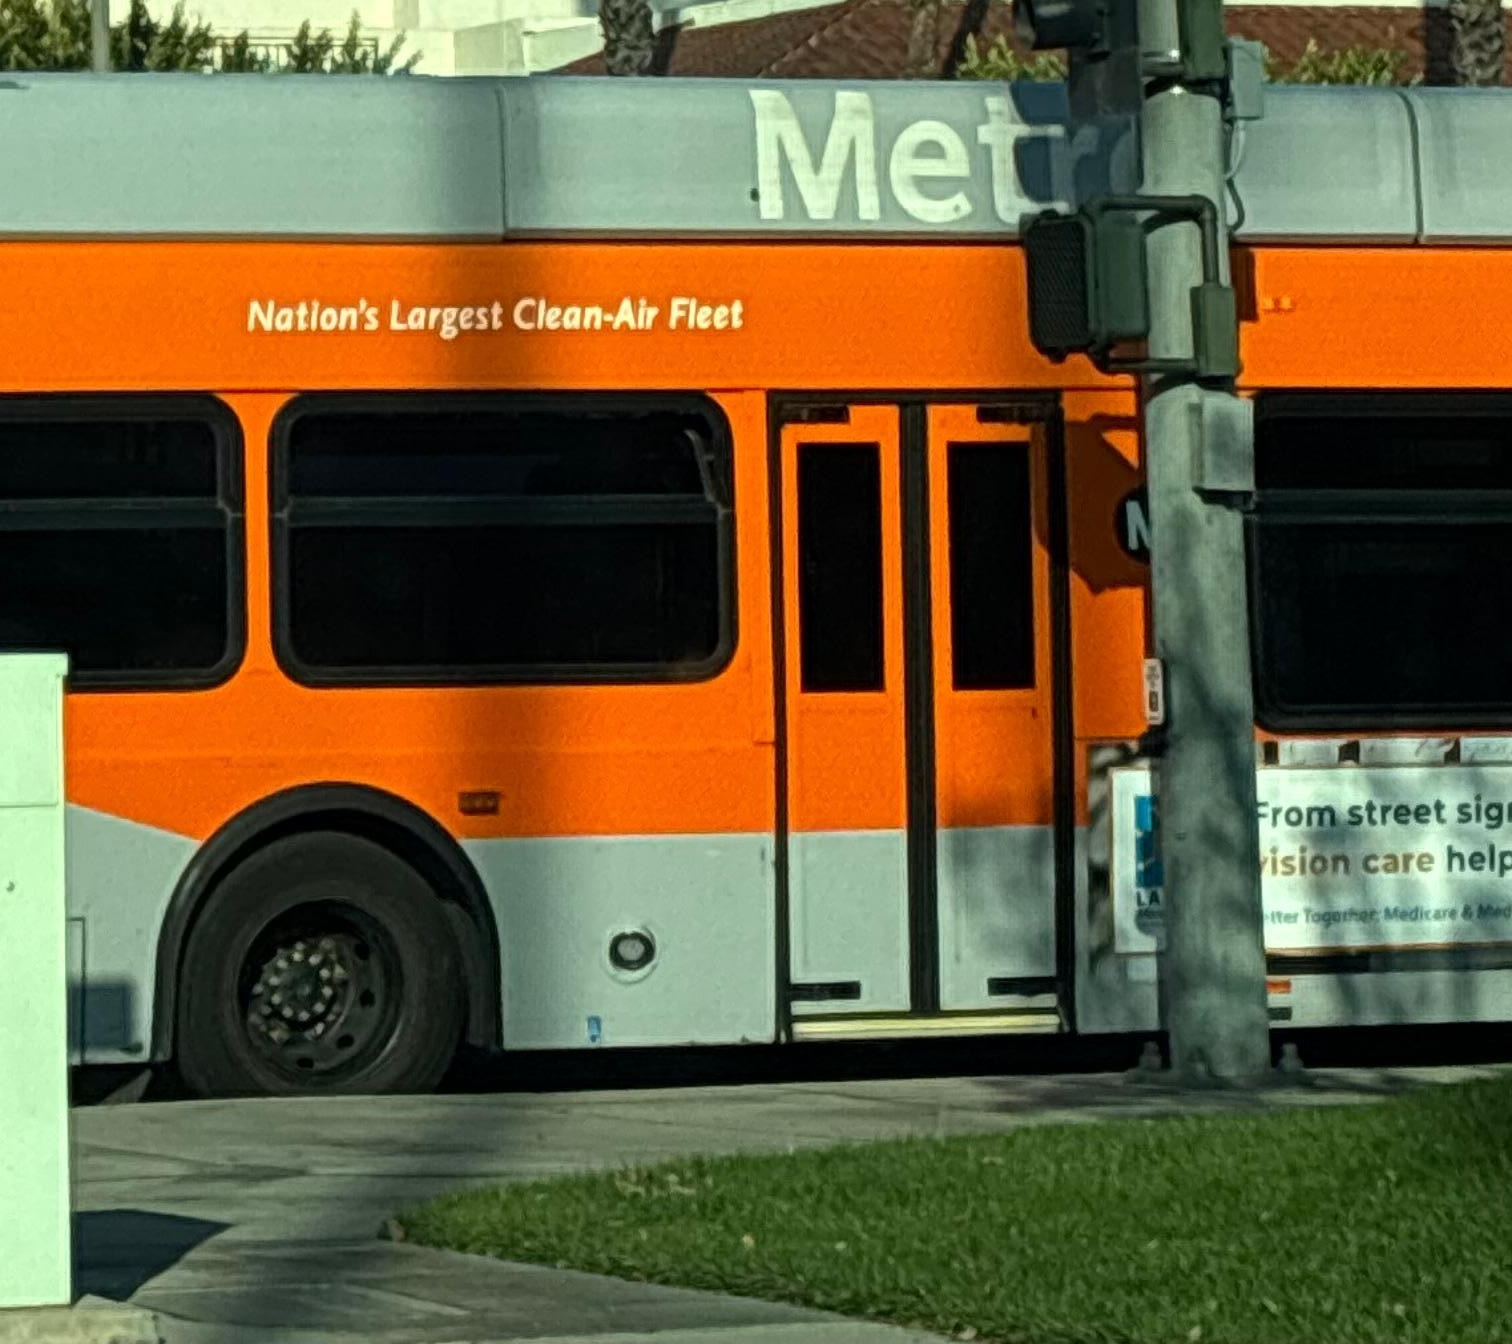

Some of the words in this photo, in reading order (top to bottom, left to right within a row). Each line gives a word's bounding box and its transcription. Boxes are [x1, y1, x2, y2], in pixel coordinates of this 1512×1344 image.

[247, 298, 379, 332] Nation's
[389, 299, 503, 340] Largest
[513, 297, 659, 331] Clean-Air
[669, 297, 744, 330] Fleet
[1348, 798, 1446, 827] street
[1362, 851, 1435, 875] care
